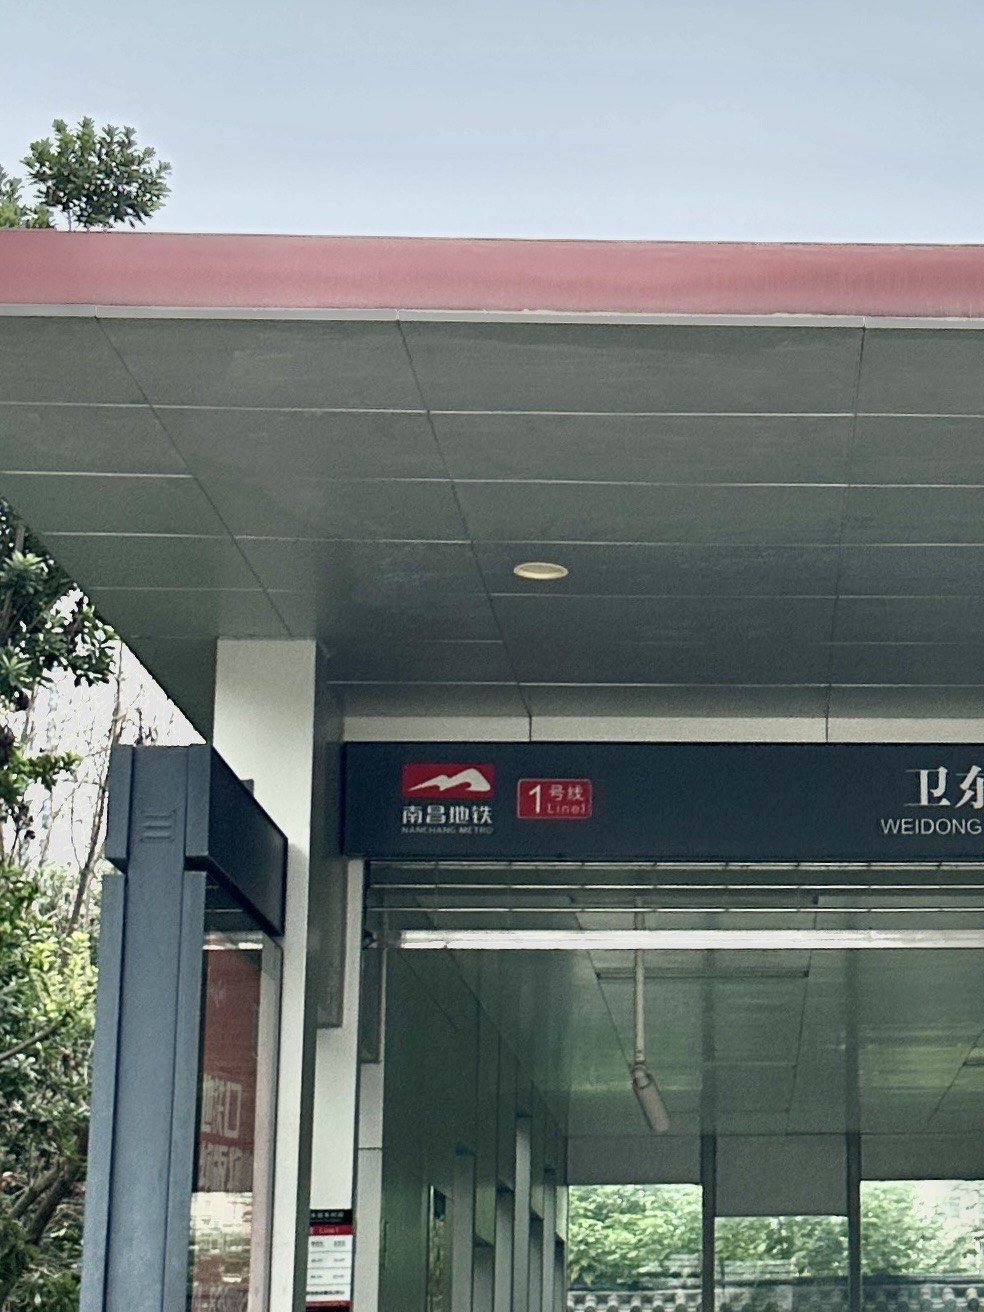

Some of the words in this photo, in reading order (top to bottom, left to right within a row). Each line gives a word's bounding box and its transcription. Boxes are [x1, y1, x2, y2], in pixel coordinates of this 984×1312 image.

[528, 784, 542, 815] 1
[549, 784, 585, 802] 号线
[402, 805, 493, 825] 南昌地铁
[880, 818, 982, 835] WEIDONG
